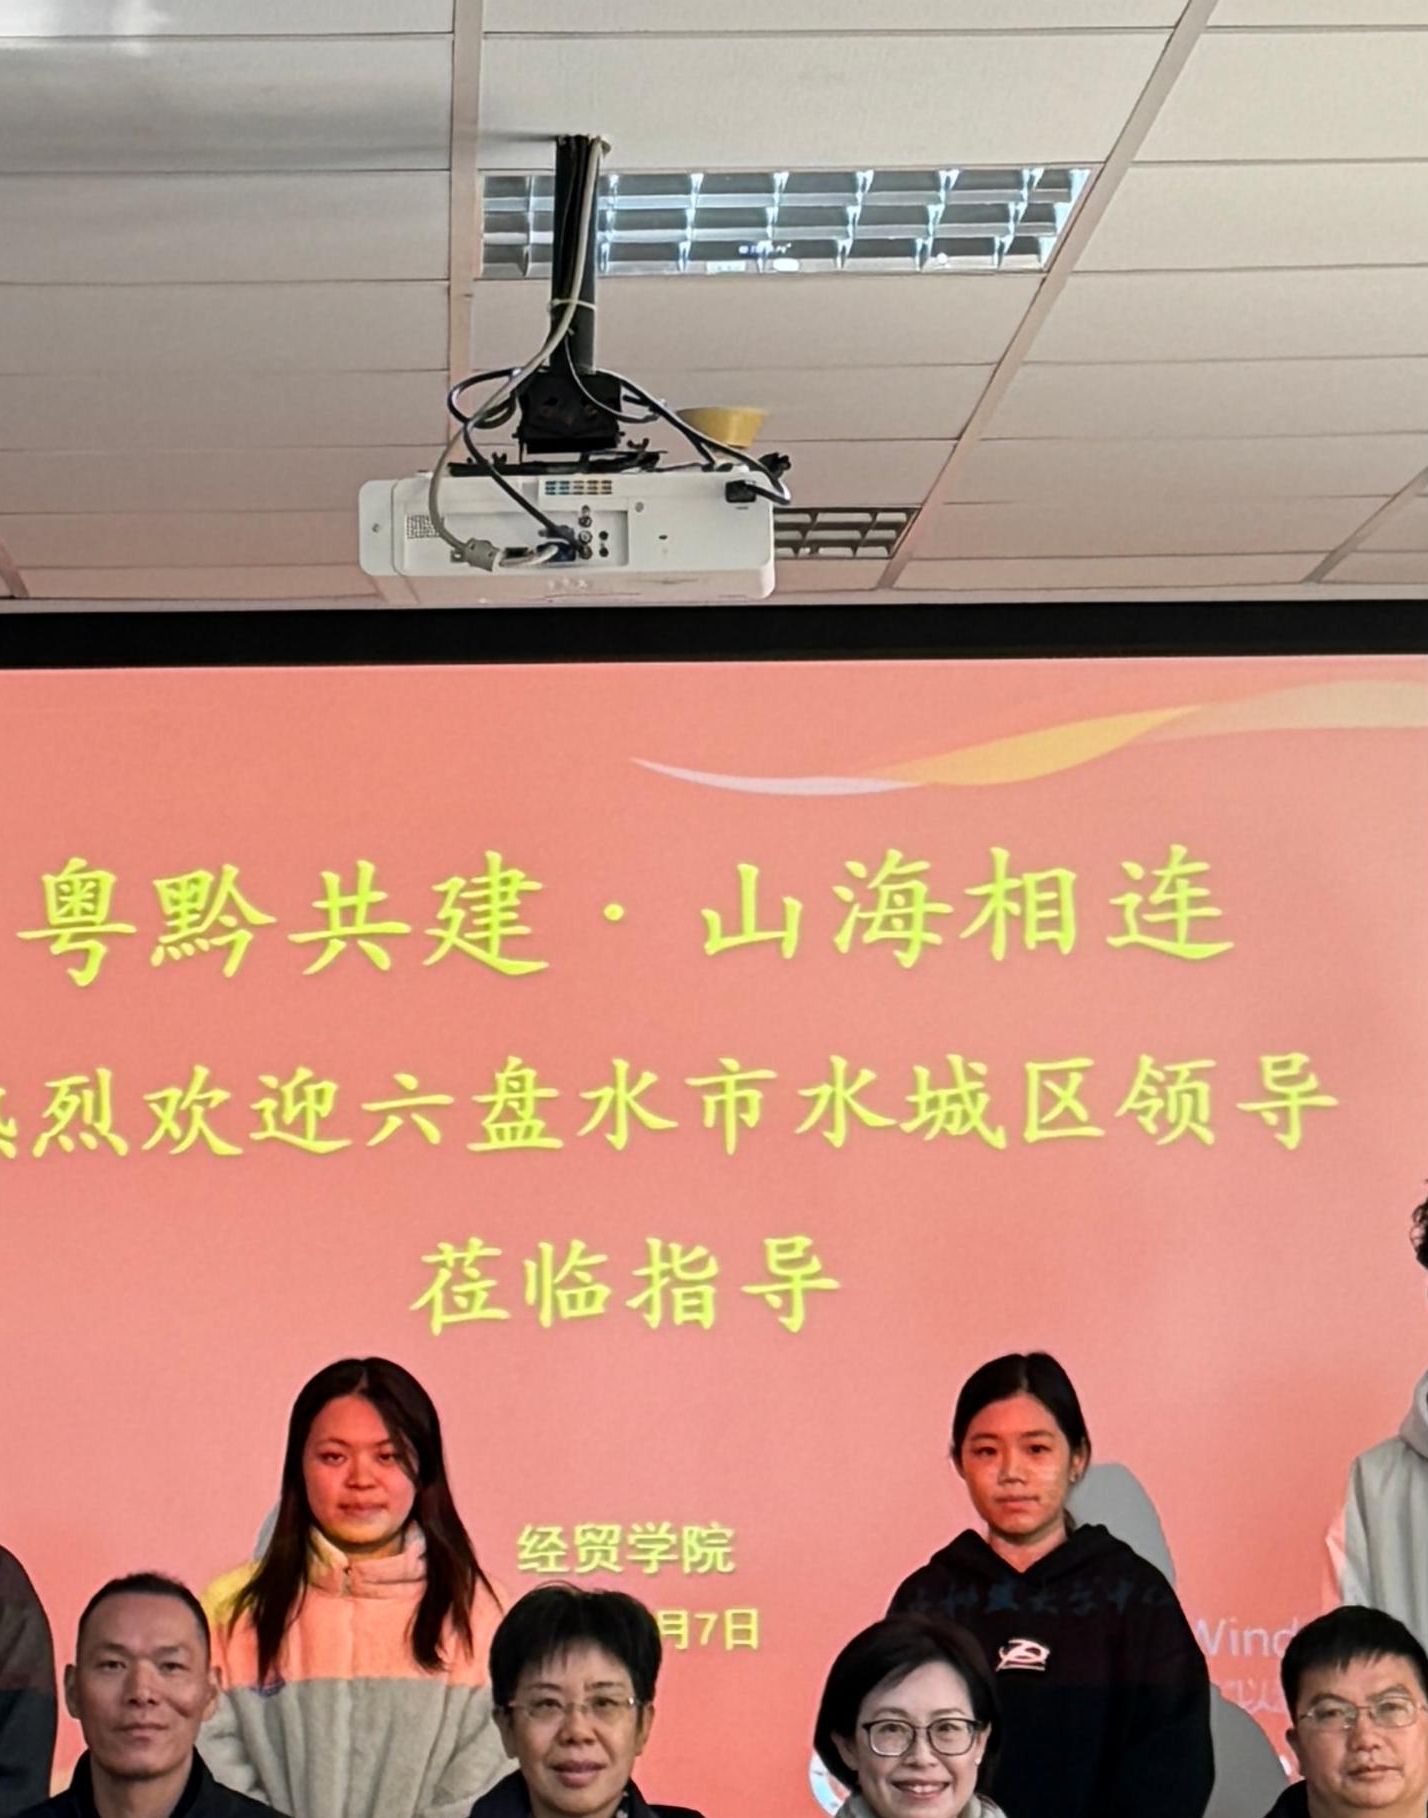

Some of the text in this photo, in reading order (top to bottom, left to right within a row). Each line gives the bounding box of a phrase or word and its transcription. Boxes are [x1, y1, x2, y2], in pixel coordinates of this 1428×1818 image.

[17, 847, 1234, 987] 粤黔共建·山海相连
[409, 1235, 842, 1336] 莅临指导
[516, 1522, 737, 1575] 经贸学院
